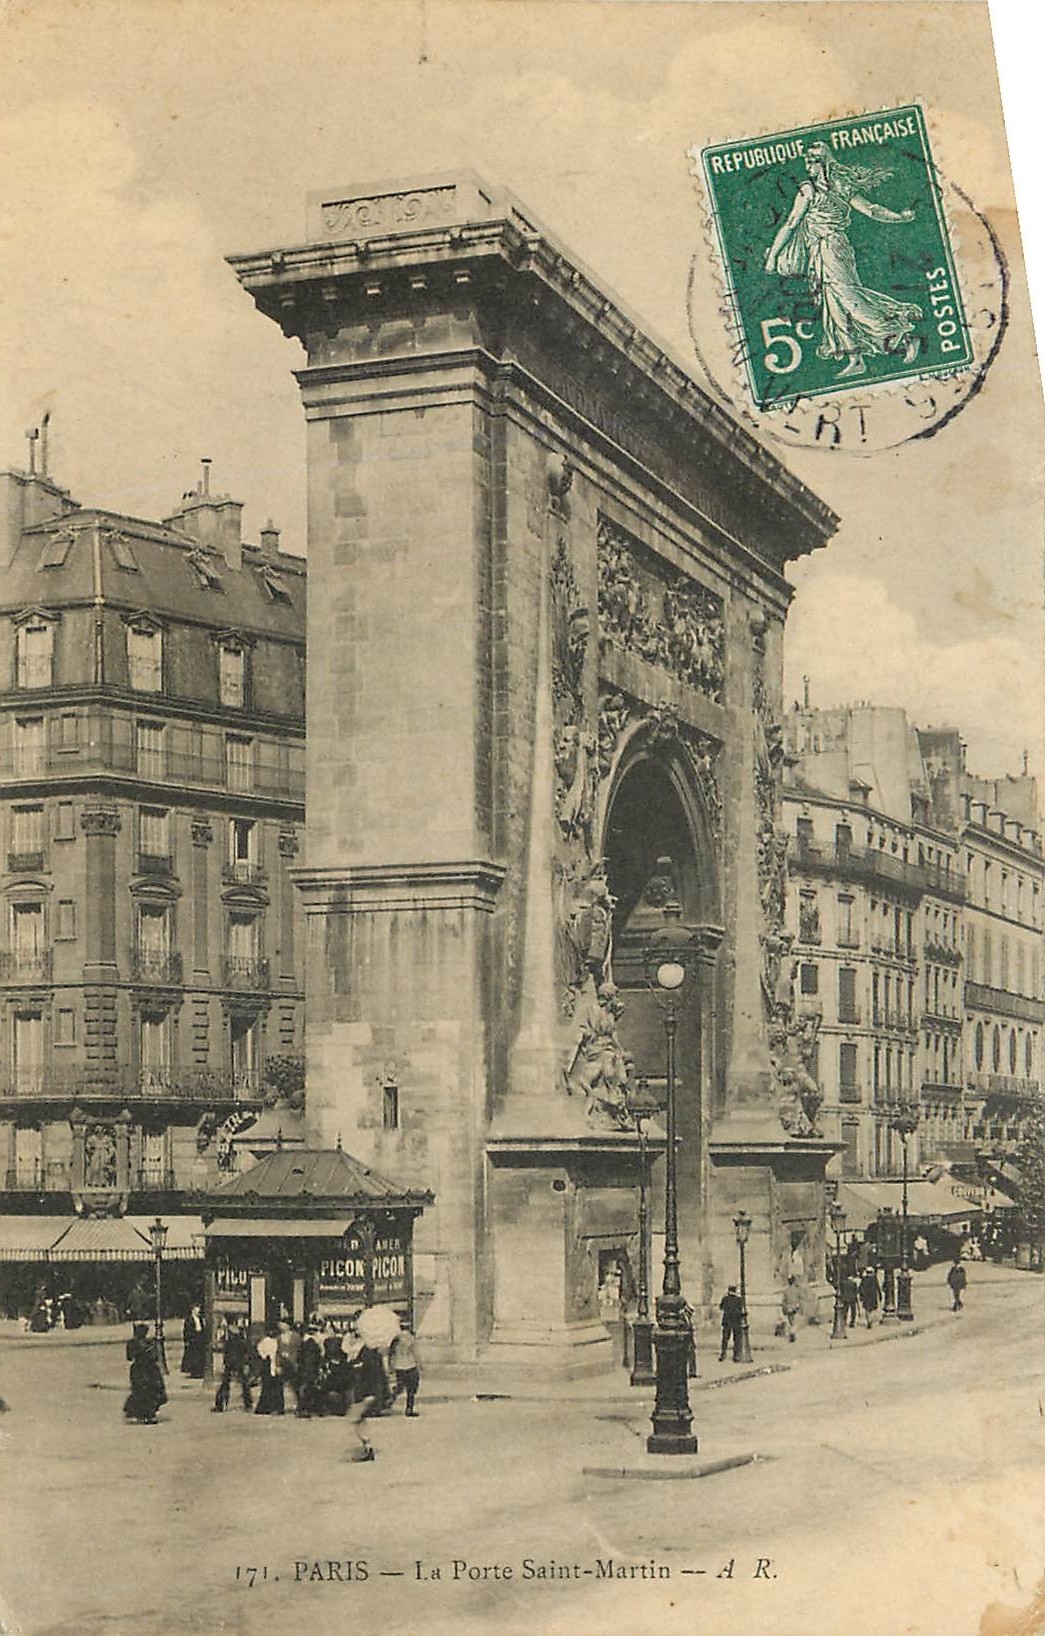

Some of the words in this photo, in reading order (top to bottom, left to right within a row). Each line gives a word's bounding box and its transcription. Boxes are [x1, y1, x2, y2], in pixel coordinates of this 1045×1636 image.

[710, 139, 807, 175] REPUBLIQUE
[830, 116, 917, 151] FRANÇAISE
[926, 266, 961, 353] POSTES
[320, 1259, 365, 1278] PICON
[372, 1255, 405, 1279] PICON
